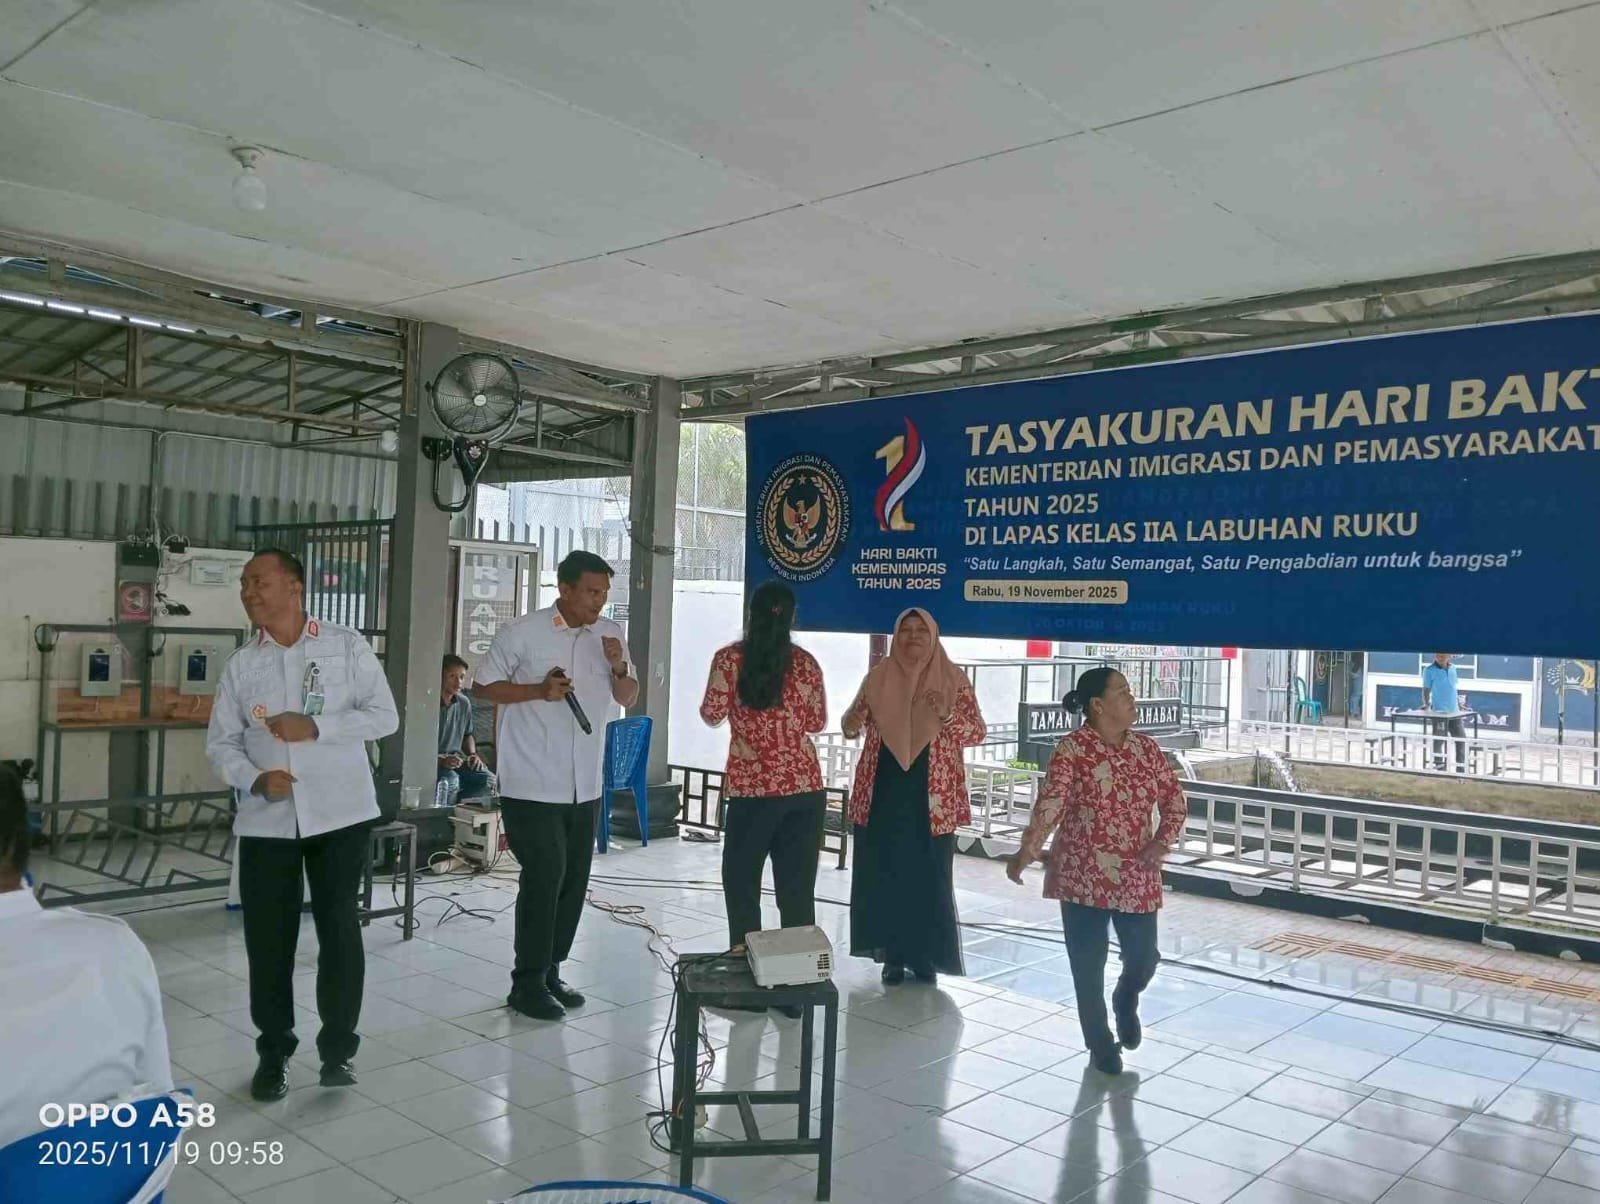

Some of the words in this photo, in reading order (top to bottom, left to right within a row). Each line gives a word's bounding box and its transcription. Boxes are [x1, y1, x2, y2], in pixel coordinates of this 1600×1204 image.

[964, 399, 1273, 457] TASYAKURAN
[1287, 384, 1430, 432] HARI
[965, 458, 1121, 487] KEMENTERIAN
[1129, 449, 1252, 477] IMIGRASI
[1260, 443, 1323, 470] DAN
[964, 496, 1039, 517] TAHUN
[1046, 493, 1099, 515] 2025
[964, 526, 986, 546] DI
[992, 524, 1059, 546] LAPAS
[1066, 522, 1137, 544] KELAS
[1143, 520, 1178, 543] IIA
[1186, 515, 1322, 542] LABUHAN
[1333, 512, 1418, 537] RUKU
[861, 547, 892, 560] HARI
[896, 547, 937, 560] BAKTI
[963, 556, 1000, 571] “Satu
[1003, 556, 1067, 574] Langkah,
[1072, 556, 1105, 571] Satu
[1110, 555, 1195, 573] Semangat,
[1200, 555, 1240, 571] Satu
[1245, 552, 1358, 574] Pengabdian
[1363, 551, 1422, 568] untuk
[1427, 549, 1522, 572] bangsa”
[851, 562, 947, 575] KEMENIMIPAS
[856, 577, 903, 590] TAHUN
[905, 578, 941, 590] 2025
[972, 585, 1004, 599] Rabu,
[1008, 585, 1021, 598] 19
[1024, 585, 1084, 599] November
[1088, 586, 1118, 600] 2025
[468, 566, 499, 655] RUANG
[1031, 711, 1073, 730] TAMAN
